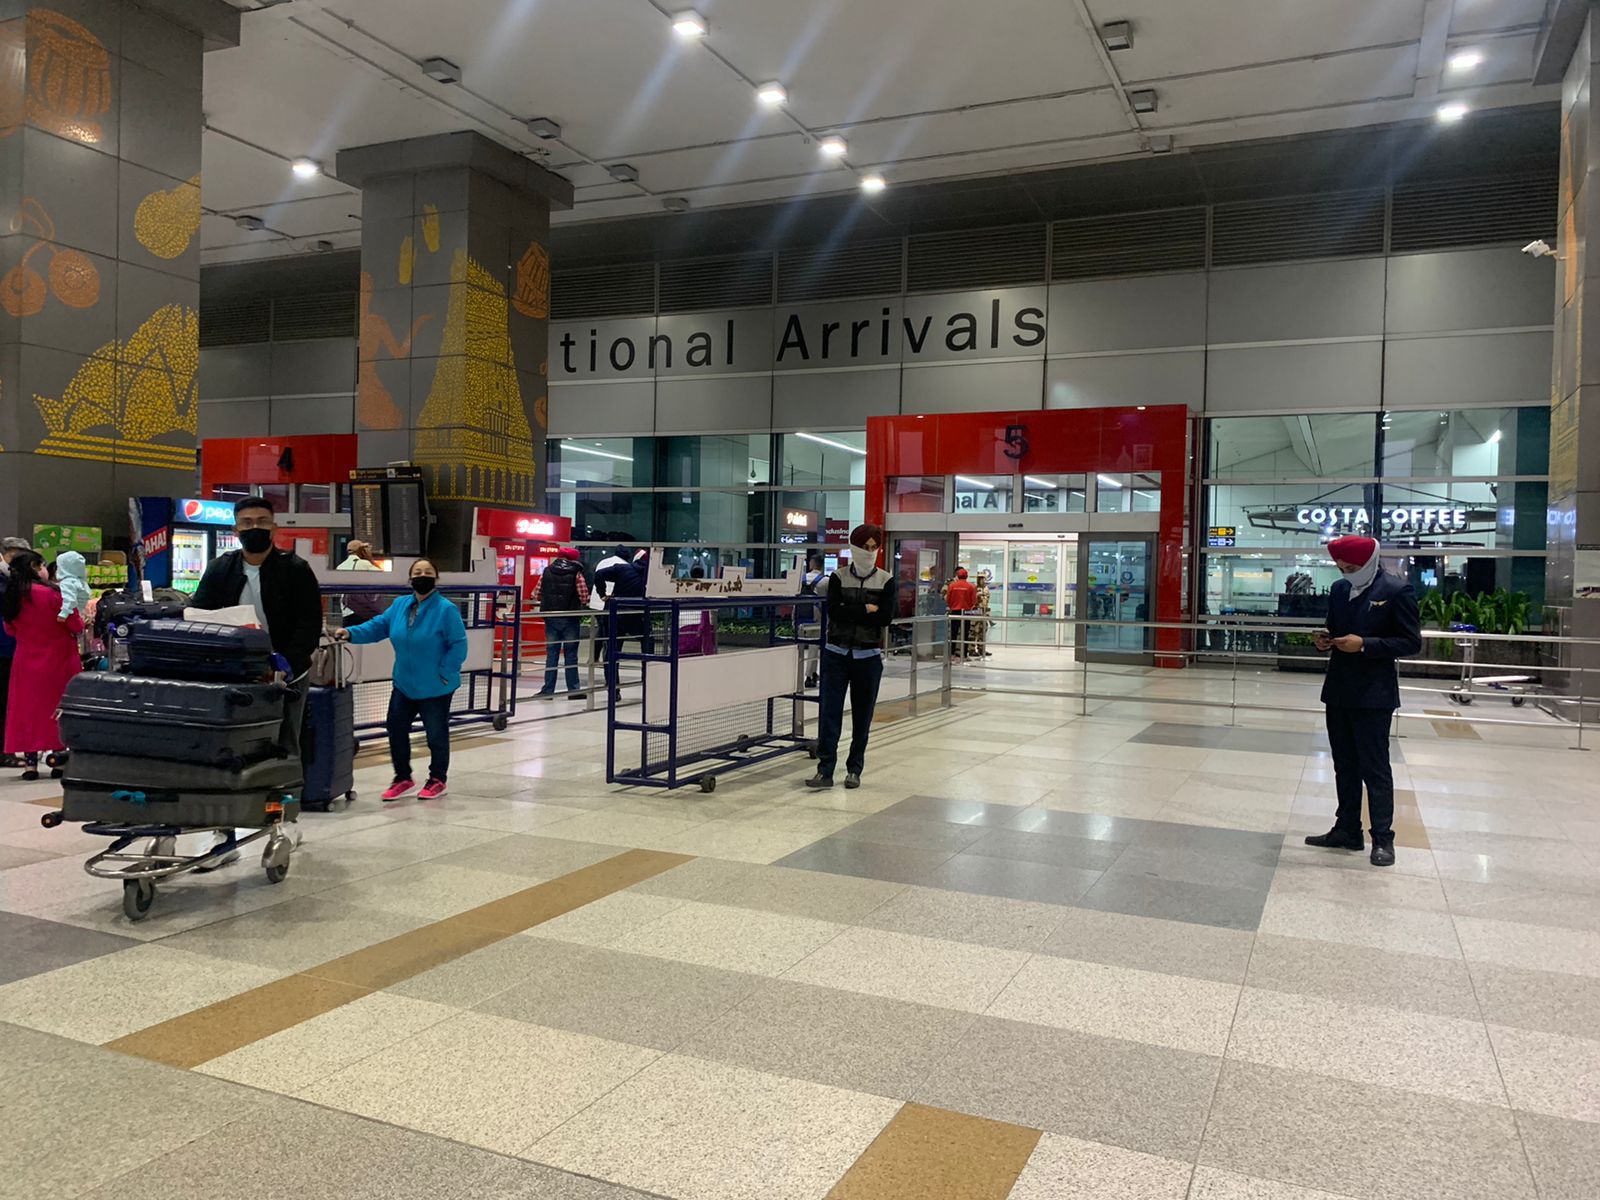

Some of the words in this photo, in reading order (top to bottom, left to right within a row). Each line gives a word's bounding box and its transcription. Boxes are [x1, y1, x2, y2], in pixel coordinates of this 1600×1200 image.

[560, 319, 734, 373] tional
[776, 298, 1046, 363] Arrivals
[1003, 425, 1028, 459] 5
[277, 447, 294, 472] 4
[205, 506, 233, 520] pep
[1297, 508, 1369, 525] COSTA
[1381, 508, 1466, 525] COFFEE
